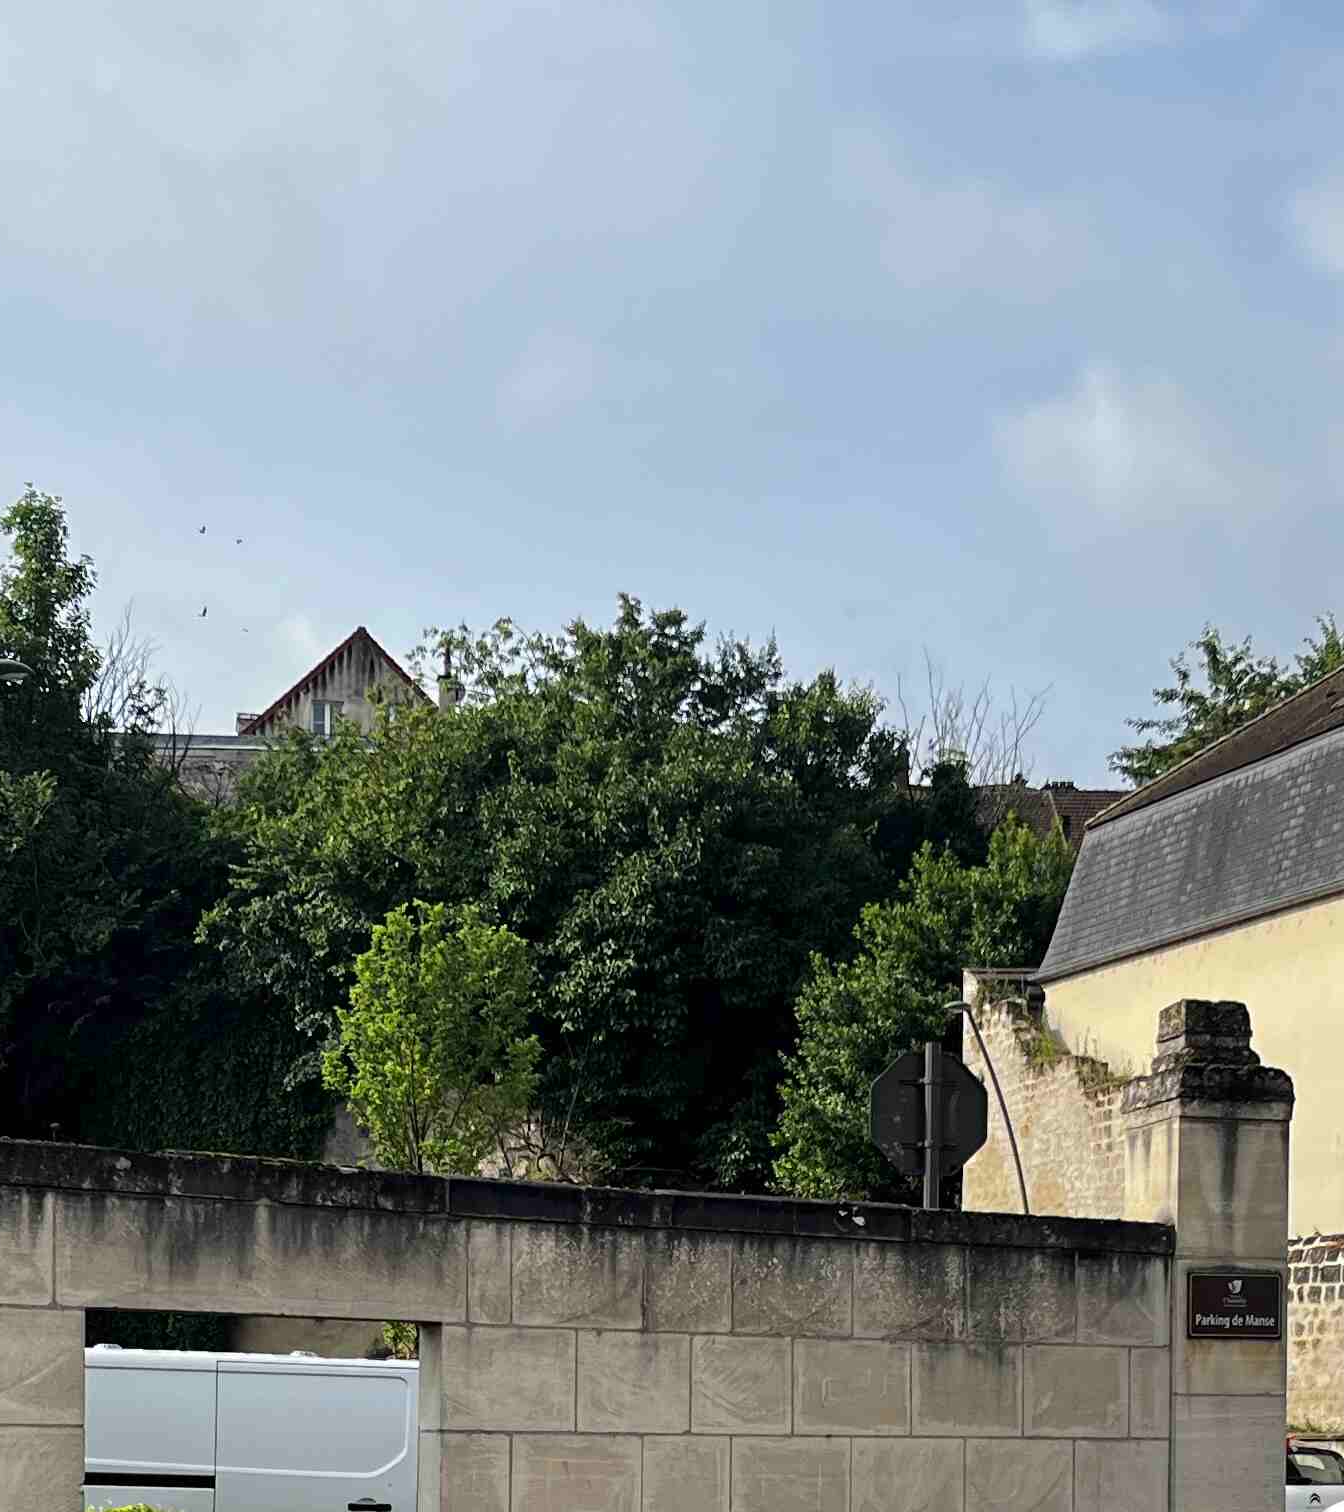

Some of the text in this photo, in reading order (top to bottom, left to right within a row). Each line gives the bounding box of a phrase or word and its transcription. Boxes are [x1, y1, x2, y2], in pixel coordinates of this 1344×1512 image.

[1195, 1313, 1276, 1329] Parking de Manse
